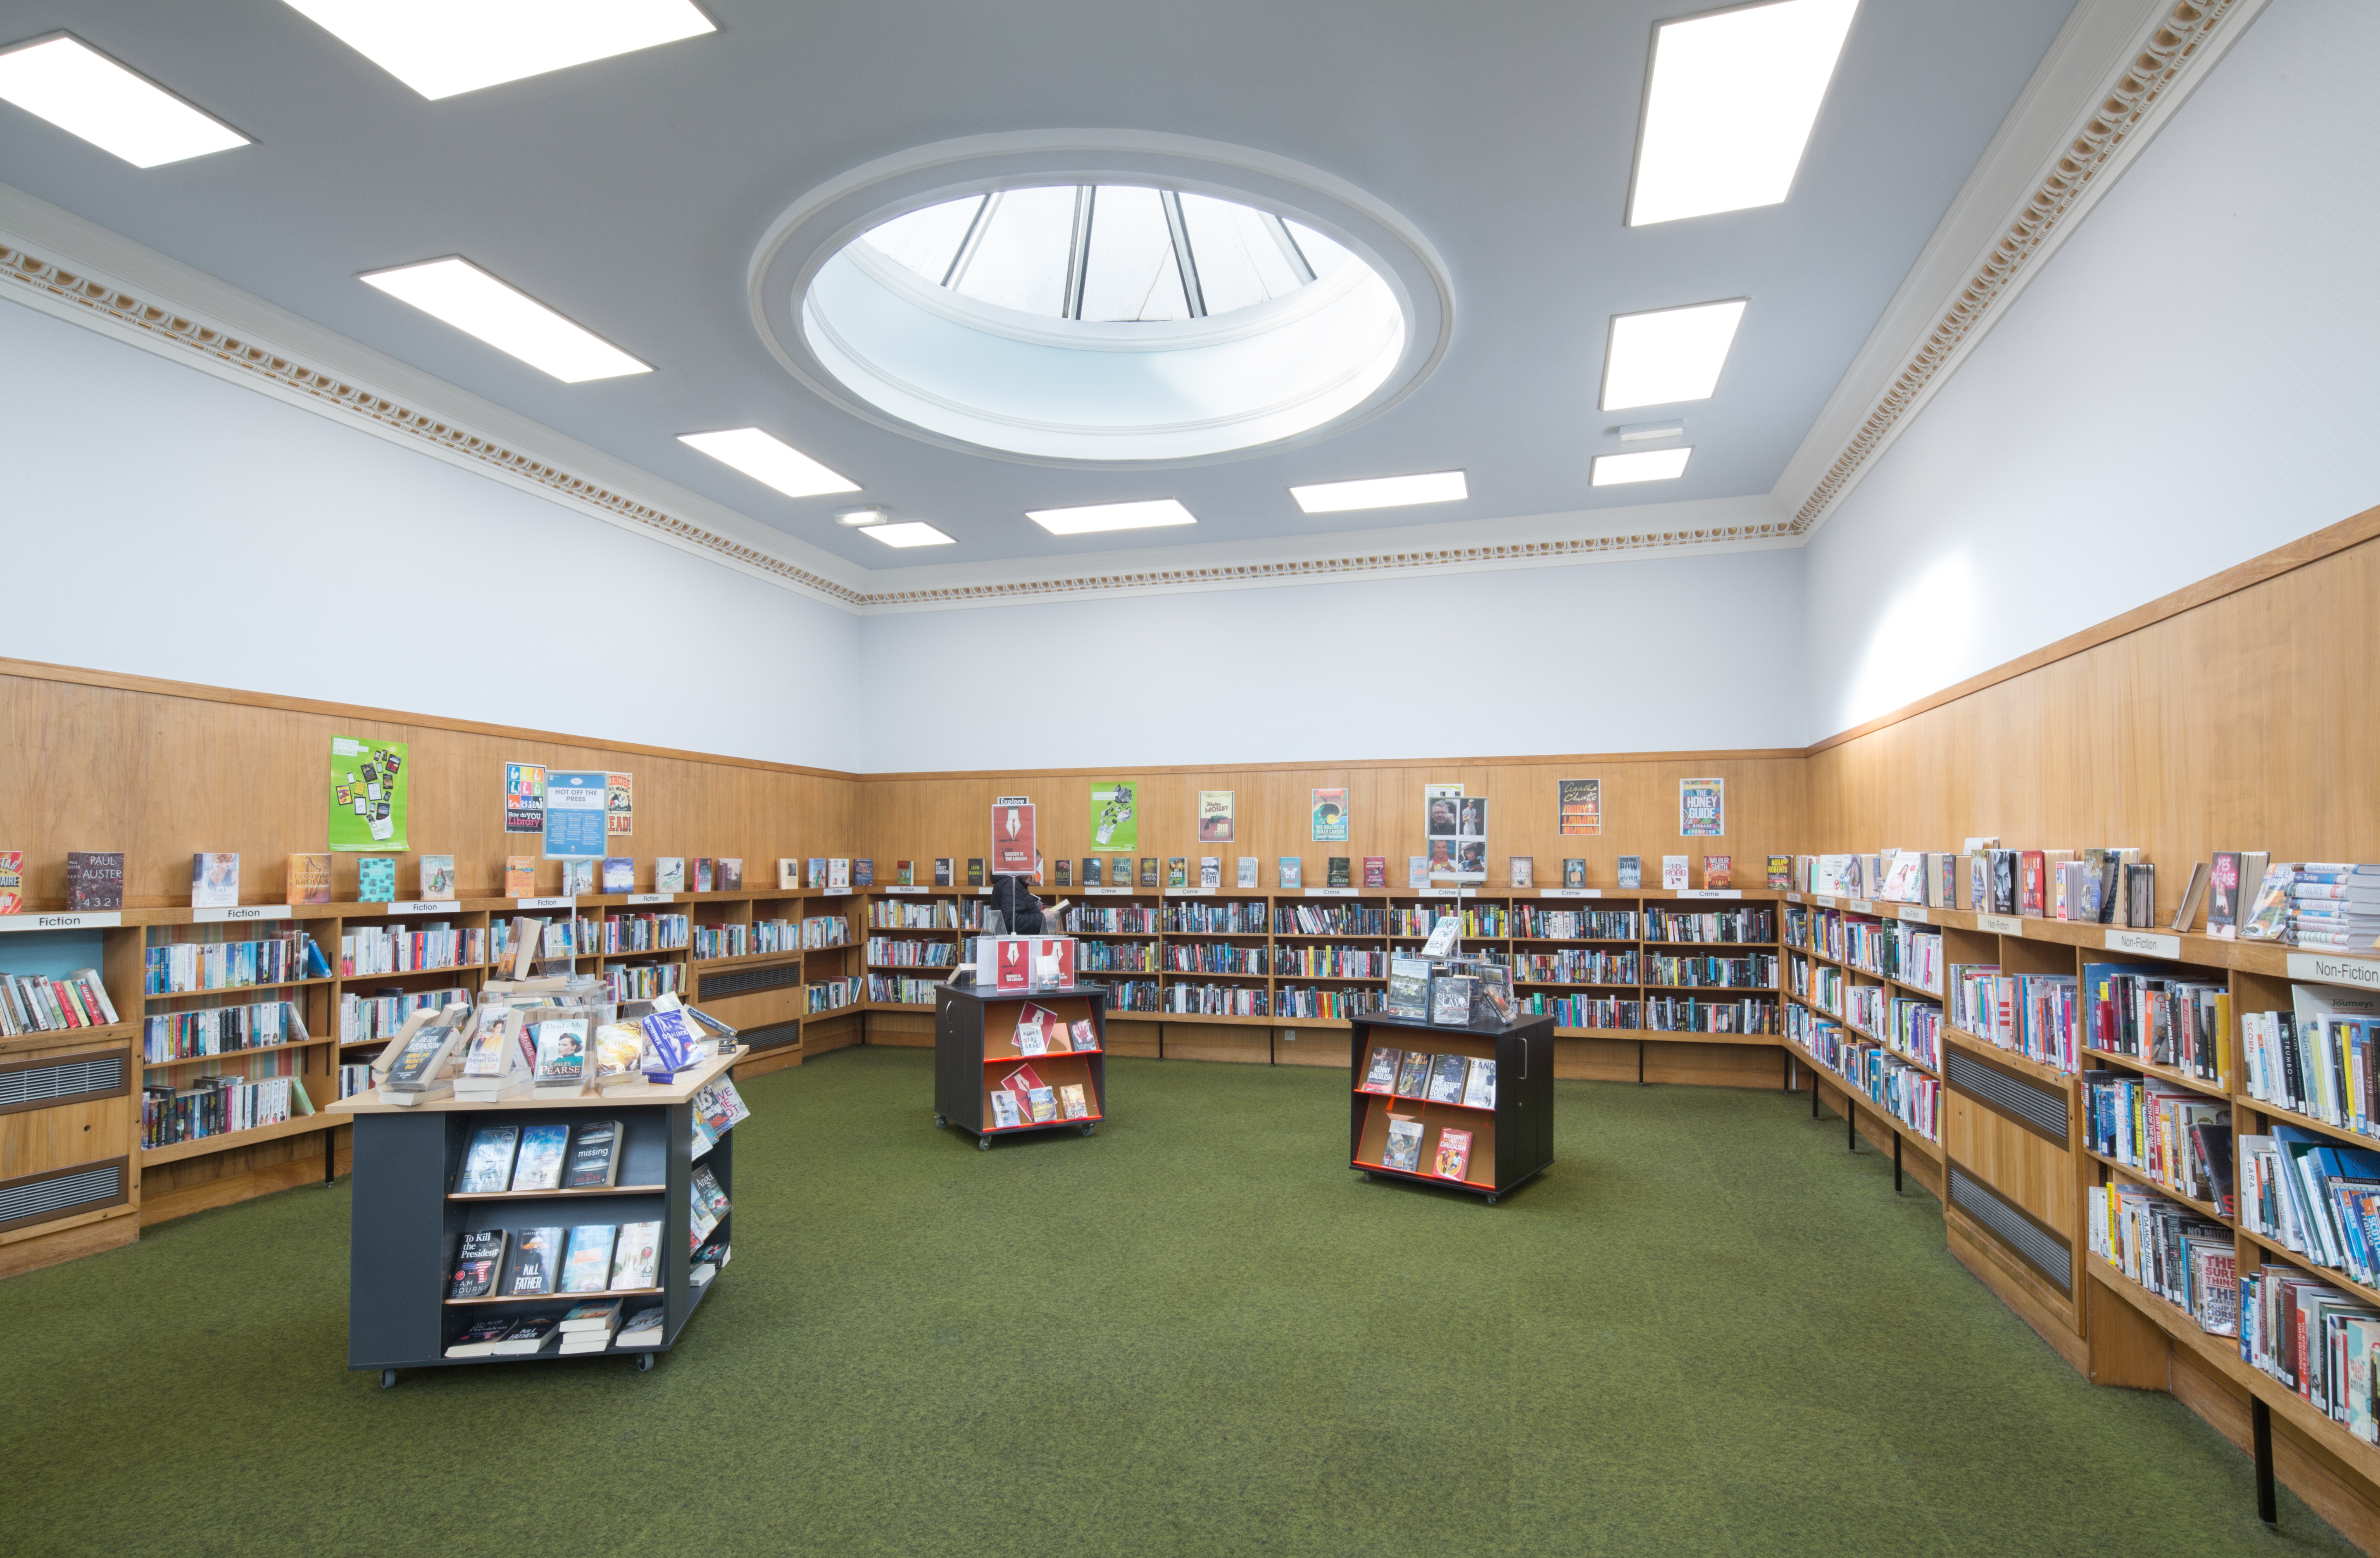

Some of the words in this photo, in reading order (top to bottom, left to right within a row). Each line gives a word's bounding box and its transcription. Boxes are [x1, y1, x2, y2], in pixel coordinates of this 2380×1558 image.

[609, 775, 630, 788] ERCISE
[1564, 783, 1597, 794] Agatha
[1564, 793, 1597, 803] Christie
[1687, 796, 1717, 808] HONEY
[1689, 807, 1715, 819] GUIDE
[508, 817, 543, 827] Library?
[609, 816, 631, 832] EAD!
[90, 856, 115, 865] PAUL
[2218, 858, 2230, 871] YES
[83, 869, 121, 878] AUSTER
[2303, 874, 2319, 882] Turkey
[1206, 875, 1218, 884] EVIL
[2297, 886, 2324, 896] EUROPE
[2301, 901, 2333, 909] CARIBBEAN
[228, 909, 260, 918] Fiction
[39, 917, 81, 926] Fiction
[1987, 919, 2009, 930] Non-Fiction
[2121, 936, 2157, 950] Non-Fiction
[2316, 960, 2379, 982] Non-Fiction
[1442, 999, 1465, 1007] LAW
[2331, 999, 2374, 1007] Journeys
[644, 1018, 661, 1047] DOMINA
[662, 1030, 688, 1041] DOMINA
[408, 1042, 440, 1050] ROBINSON
[2284, 1041, 2293, 1075] TRUMBO
[540, 1065, 581, 1075] PEARSE
[1369, 1071, 1392, 1081] DALGLISH
[1431, 1080, 1461, 1088] GREATEST
[1443, 1132, 1467, 1143] KEEGAN
[1440, 1142, 1467, 1151] DALGLISH
[2192, 1130, 2204, 1160] Scholes
[578, 1147, 608, 1158] missing
[576, 1175, 601, 1183] WEAVER
[696, 1170, 714, 1190] Angel
[2247, 1161, 2255, 1188] LARA
[2277, 1195, 2286, 1224] FRONTIER
[2347, 1206, 2356, 1229] BERLIN
[464, 1234, 474, 1243] To
[475, 1232, 490, 1242] Kill
[463, 1241, 476, 1251] the
[460, 1248, 499, 1259] President
[523, 1263, 539, 1276] KILL
[454, 1280, 474, 1288] SAM
[514, 1276, 543, 1290] FATHER
[452, 1284, 489, 1295] BOURNE
[2249, 1299, 2257, 1336] Australia
